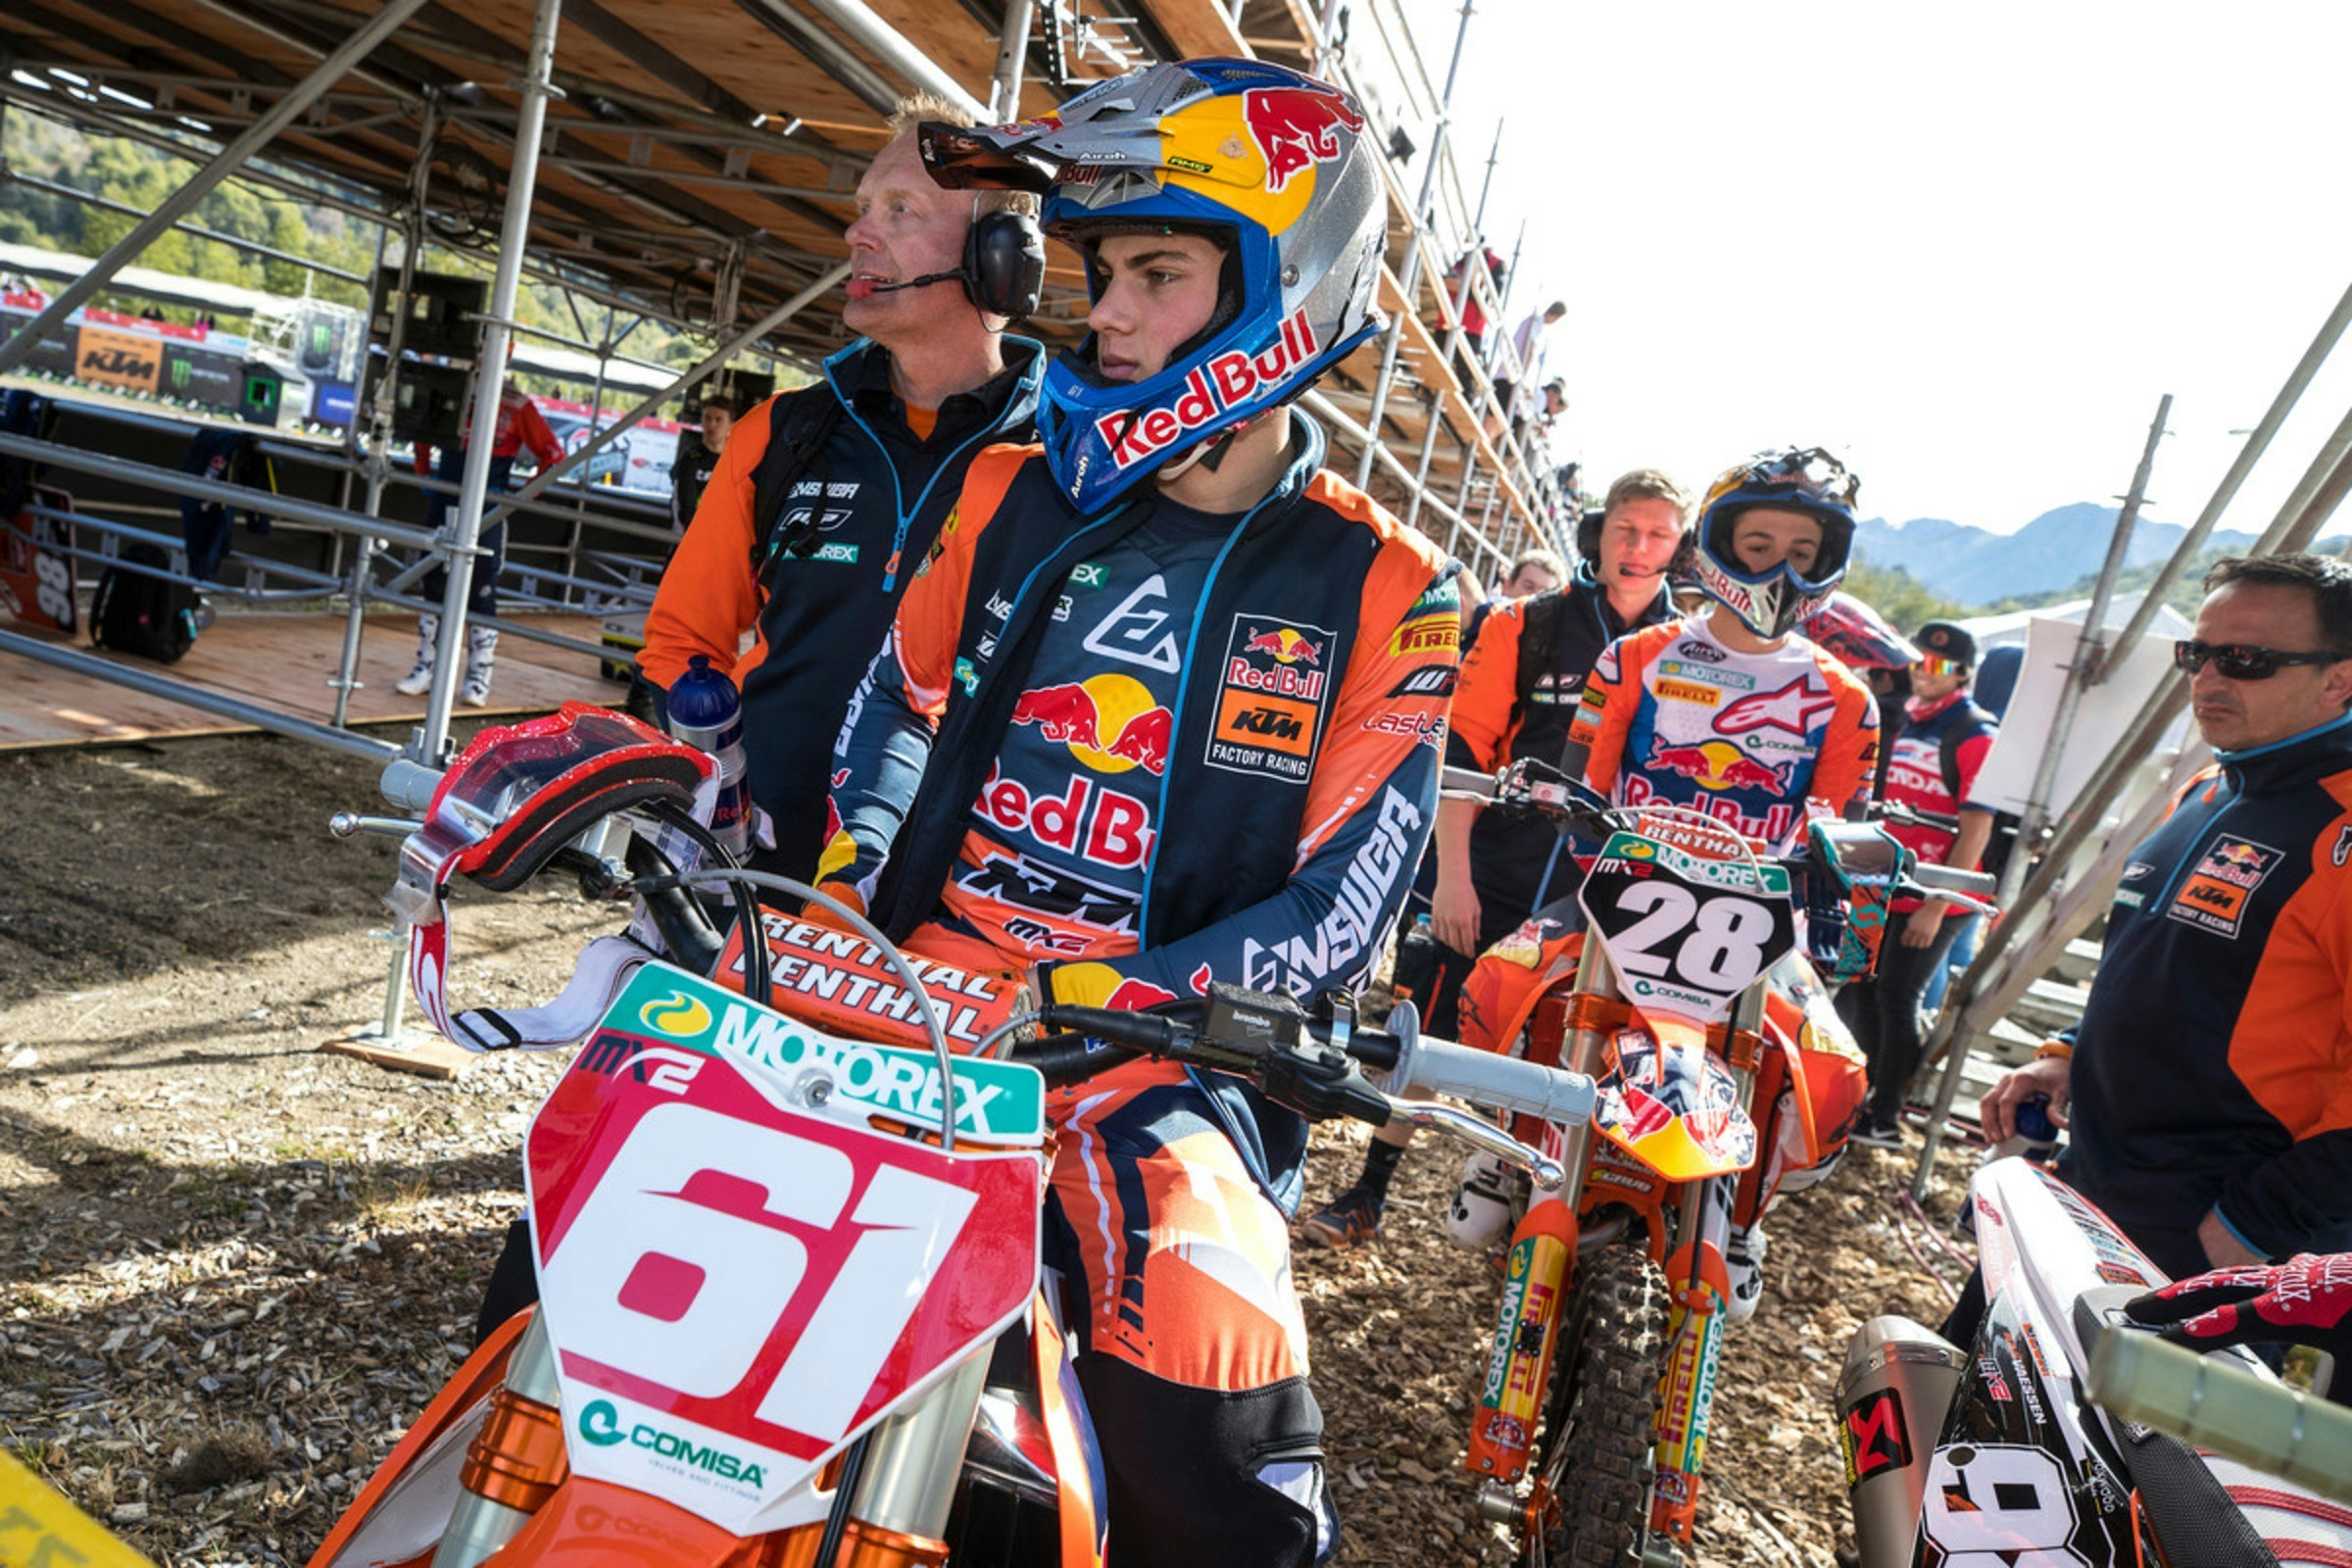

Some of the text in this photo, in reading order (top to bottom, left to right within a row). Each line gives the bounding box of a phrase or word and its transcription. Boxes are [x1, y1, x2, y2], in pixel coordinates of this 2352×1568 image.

[82, 348, 155, 379] KTM
[1095, 305, 1320, 470] Red Bull
[1226, 657, 1325, 700] Red Bull
[1657, 682, 1715, 705] PIRELLI
[1681, 664, 1752, 688] MOTOREX
[1231, 706, 1303, 741] KTM
[1212, 743, 1308, 775] FACTORY RACING
[1626, 773, 1709, 827] Red
[1708, 797, 1792, 845] Bull
[956, 851, 1144, 937] KTM
[1597, 858, 1654, 879] MX2
[1656, 845, 1771, 892] MOTOREX
[2187, 886, 2234, 908] KTM
[1004, 915, 1096, 955] MX2
[1608, 881, 1775, 992] 28
[577, 1038, 706, 1094] MX2
[712, 1003, 1005, 1134] MOTOREX
[543, 1102, 979, 1444] 61
[1484, 1282, 1522, 1402] MOTOREX
[1693, 1308, 1727, 1436] MOTOREX
[1659, 1329, 1699, 1445] PIRELLI
[2012, 1358, 2047, 1424] VAESSEN
[631, 1424, 763, 1489] COMISA
